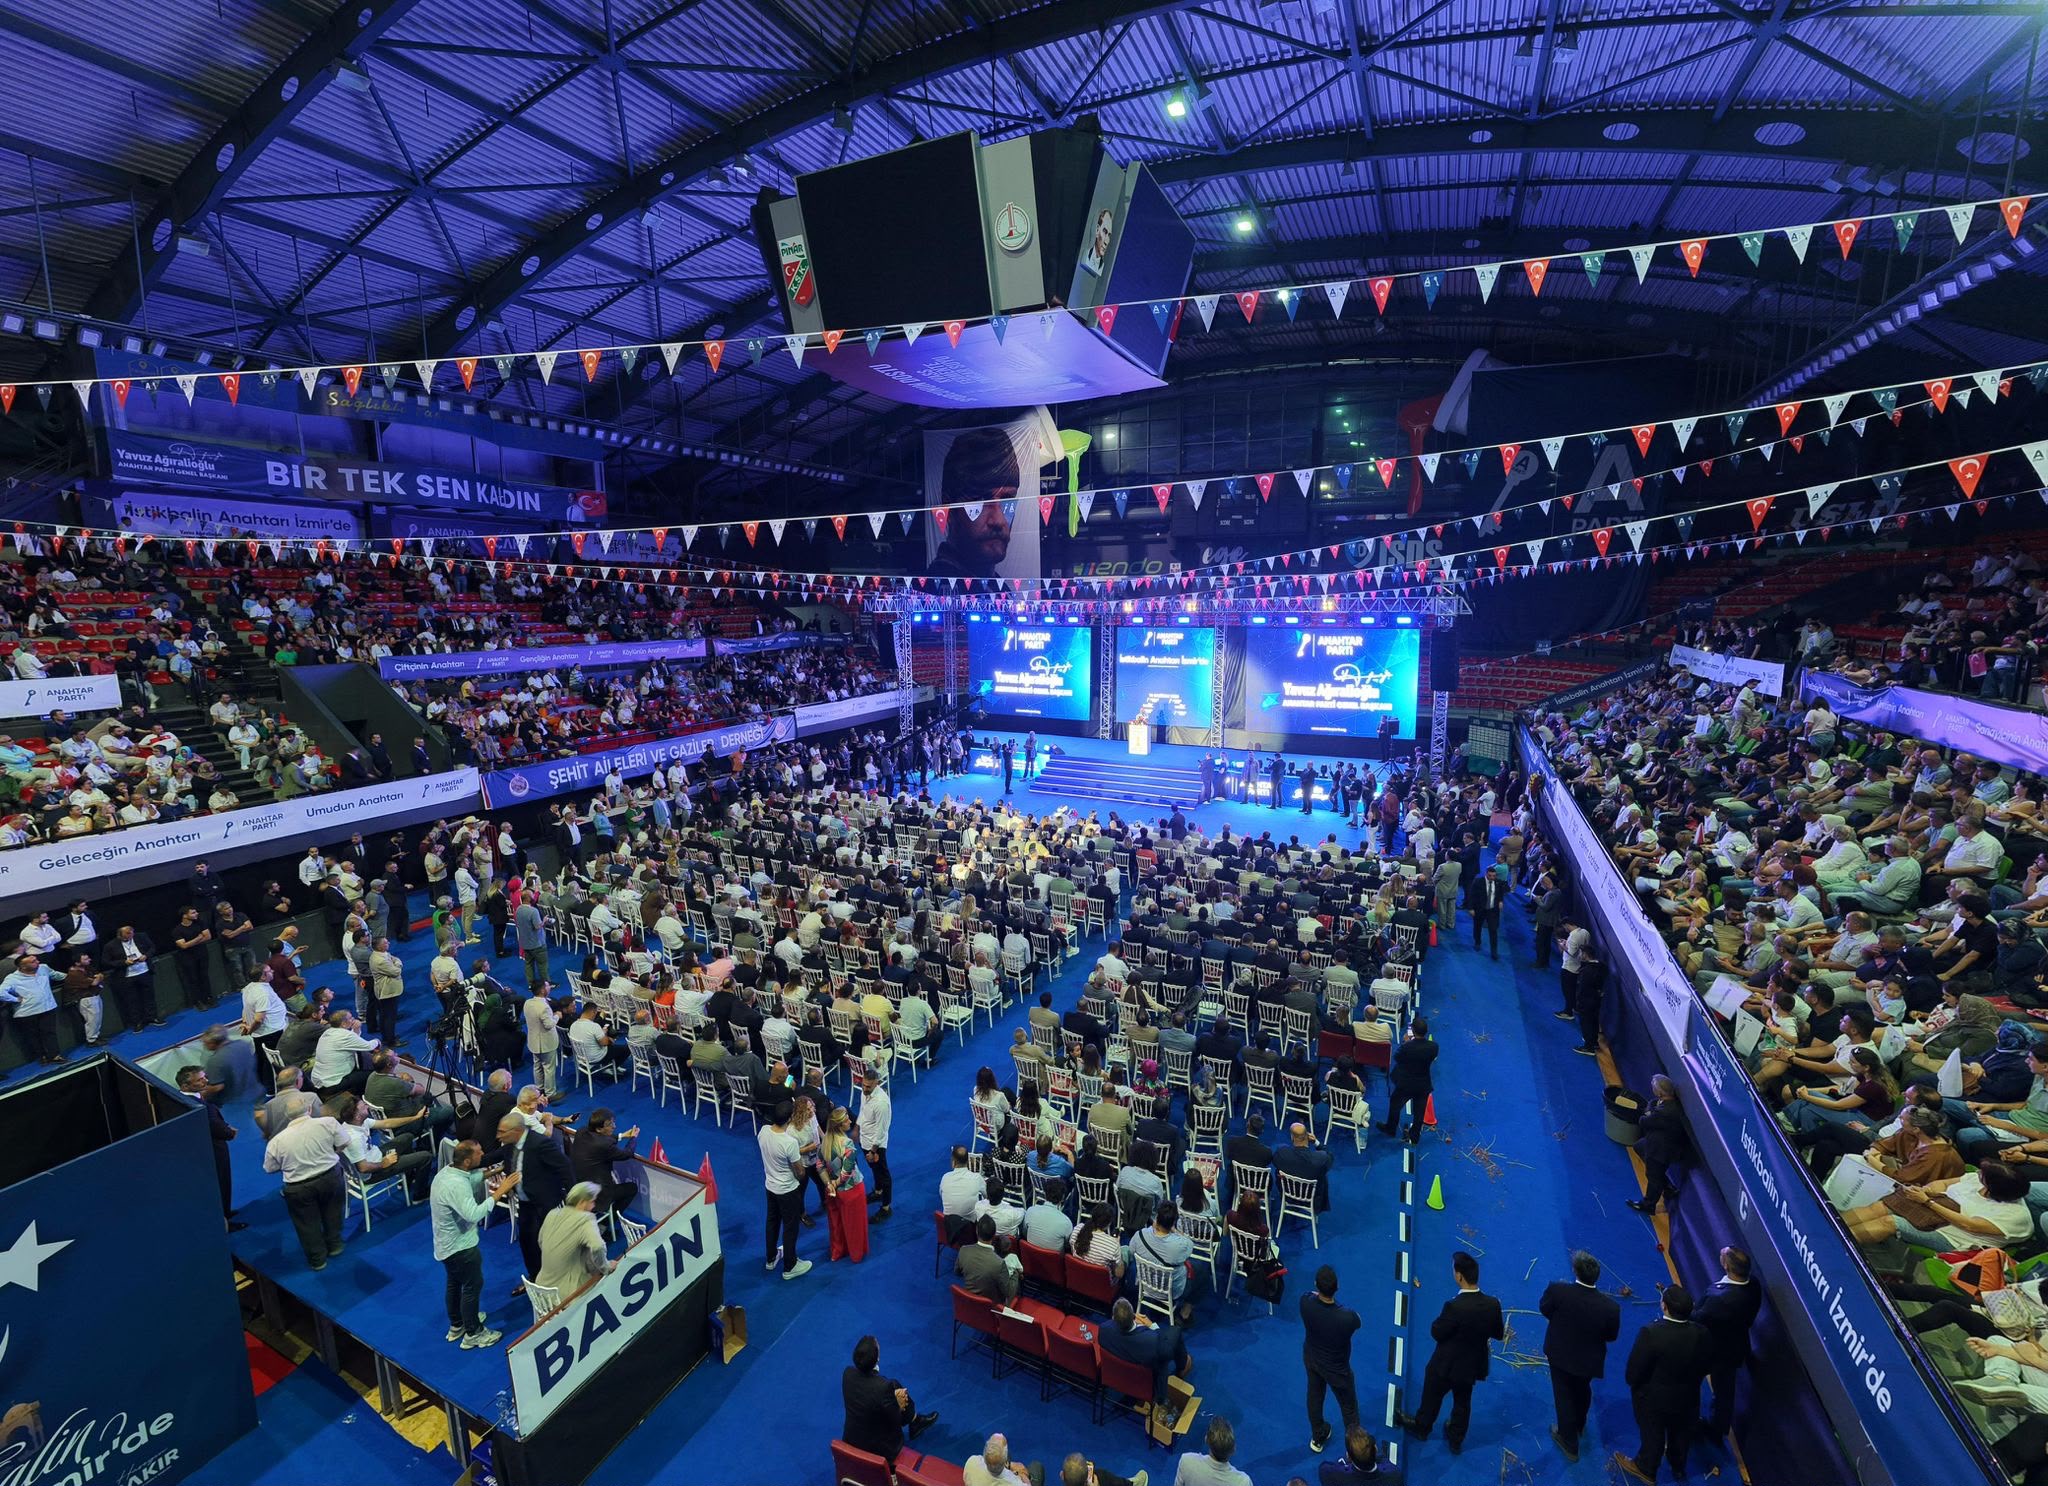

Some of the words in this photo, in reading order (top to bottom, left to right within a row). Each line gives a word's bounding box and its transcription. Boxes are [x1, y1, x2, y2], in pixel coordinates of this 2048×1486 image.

[116, 448, 152, 463] Yavuz
[154, 452, 215, 472] Ağıralioğlu
[118, 461, 152, 471] ANAHTAR
[176, 468, 198, 477] GENEL
[265, 460, 328, 491] BİR
[338, 467, 407, 495] TEK
[416, 474, 471, 501] SEN
[220, 511, 289, 527] Anahtarı
[295, 513, 352, 532] İzmir'de
[1018, 632, 1051, 642] ANAHTAR
[1317, 635, 1363, 646] ANAHTAR
[1326, 645, 1353, 656] PARTİ
[519, 653, 551, 665] Gençliğin
[552, 652, 579, 661] Anahtarı
[394, 661, 429, 673] Çiftçinin
[430, 660, 465, 670] Anahtarı
[1283, 682, 1316, 696] Yavuz
[1554, 689, 1589, 705] İstikbalin
[1590, 675, 1624, 692] Anahtarı
[1624, 662, 1656, 678] İzmir'de
[46, 687, 94, 697] ANAHTAR
[57, 694, 86, 702] PARTİ
[548, 762, 590, 789] ŞEHİT
[594, 748, 648, 778] AİLELERİ
[650, 745, 667, 763] VE
[720, 724, 765, 749] DERNEĞİ
[434, 778, 464, 789] ANAHTAR
[441, 784, 460, 793] PARTİ
[306, 801, 355, 818] Umudun
[358, 791, 404, 808] Anahtarı
[242, 812, 284, 827] ANAHTAR
[251, 820, 277, 832] PARTİ
[39, 844, 129, 870] Geleceğin
[134, 831, 202, 852] Anahtarı
[1740, 1118, 1780, 1208] İstikbalin
[1779, 1199, 1829, 1301] Anahtarı
[1829, 1286, 1892, 1414] İzmir'de
[533, 1212, 704, 1398] BASIN
